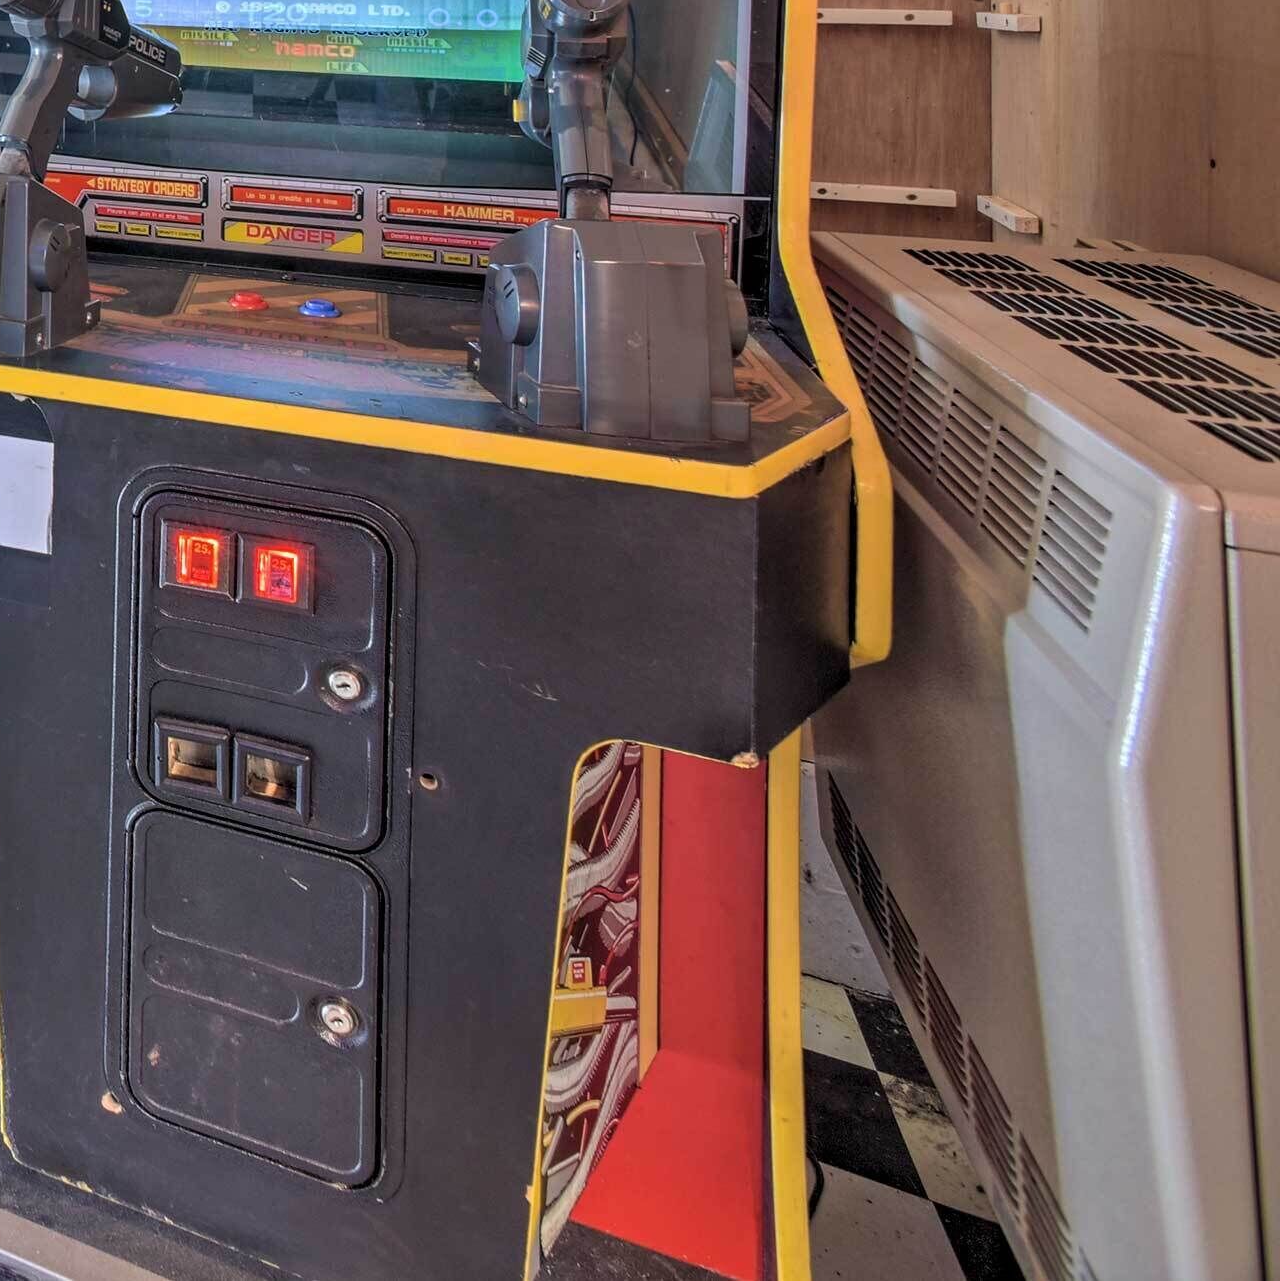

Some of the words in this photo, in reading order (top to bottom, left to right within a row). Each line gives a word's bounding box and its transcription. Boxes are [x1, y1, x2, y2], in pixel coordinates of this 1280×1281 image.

[135, 0, 164, 17] 5.
[368, 4, 411, 17] LTD.
[129, 35, 167, 64] POLICE
[275, 42, 356, 58] namco
[98, 177, 150, 194] STRATEGY
[153, 184, 195, 198] ORDERS
[443, 205, 514, 222] HAMMER
[246, 224, 336, 245] DANGER
